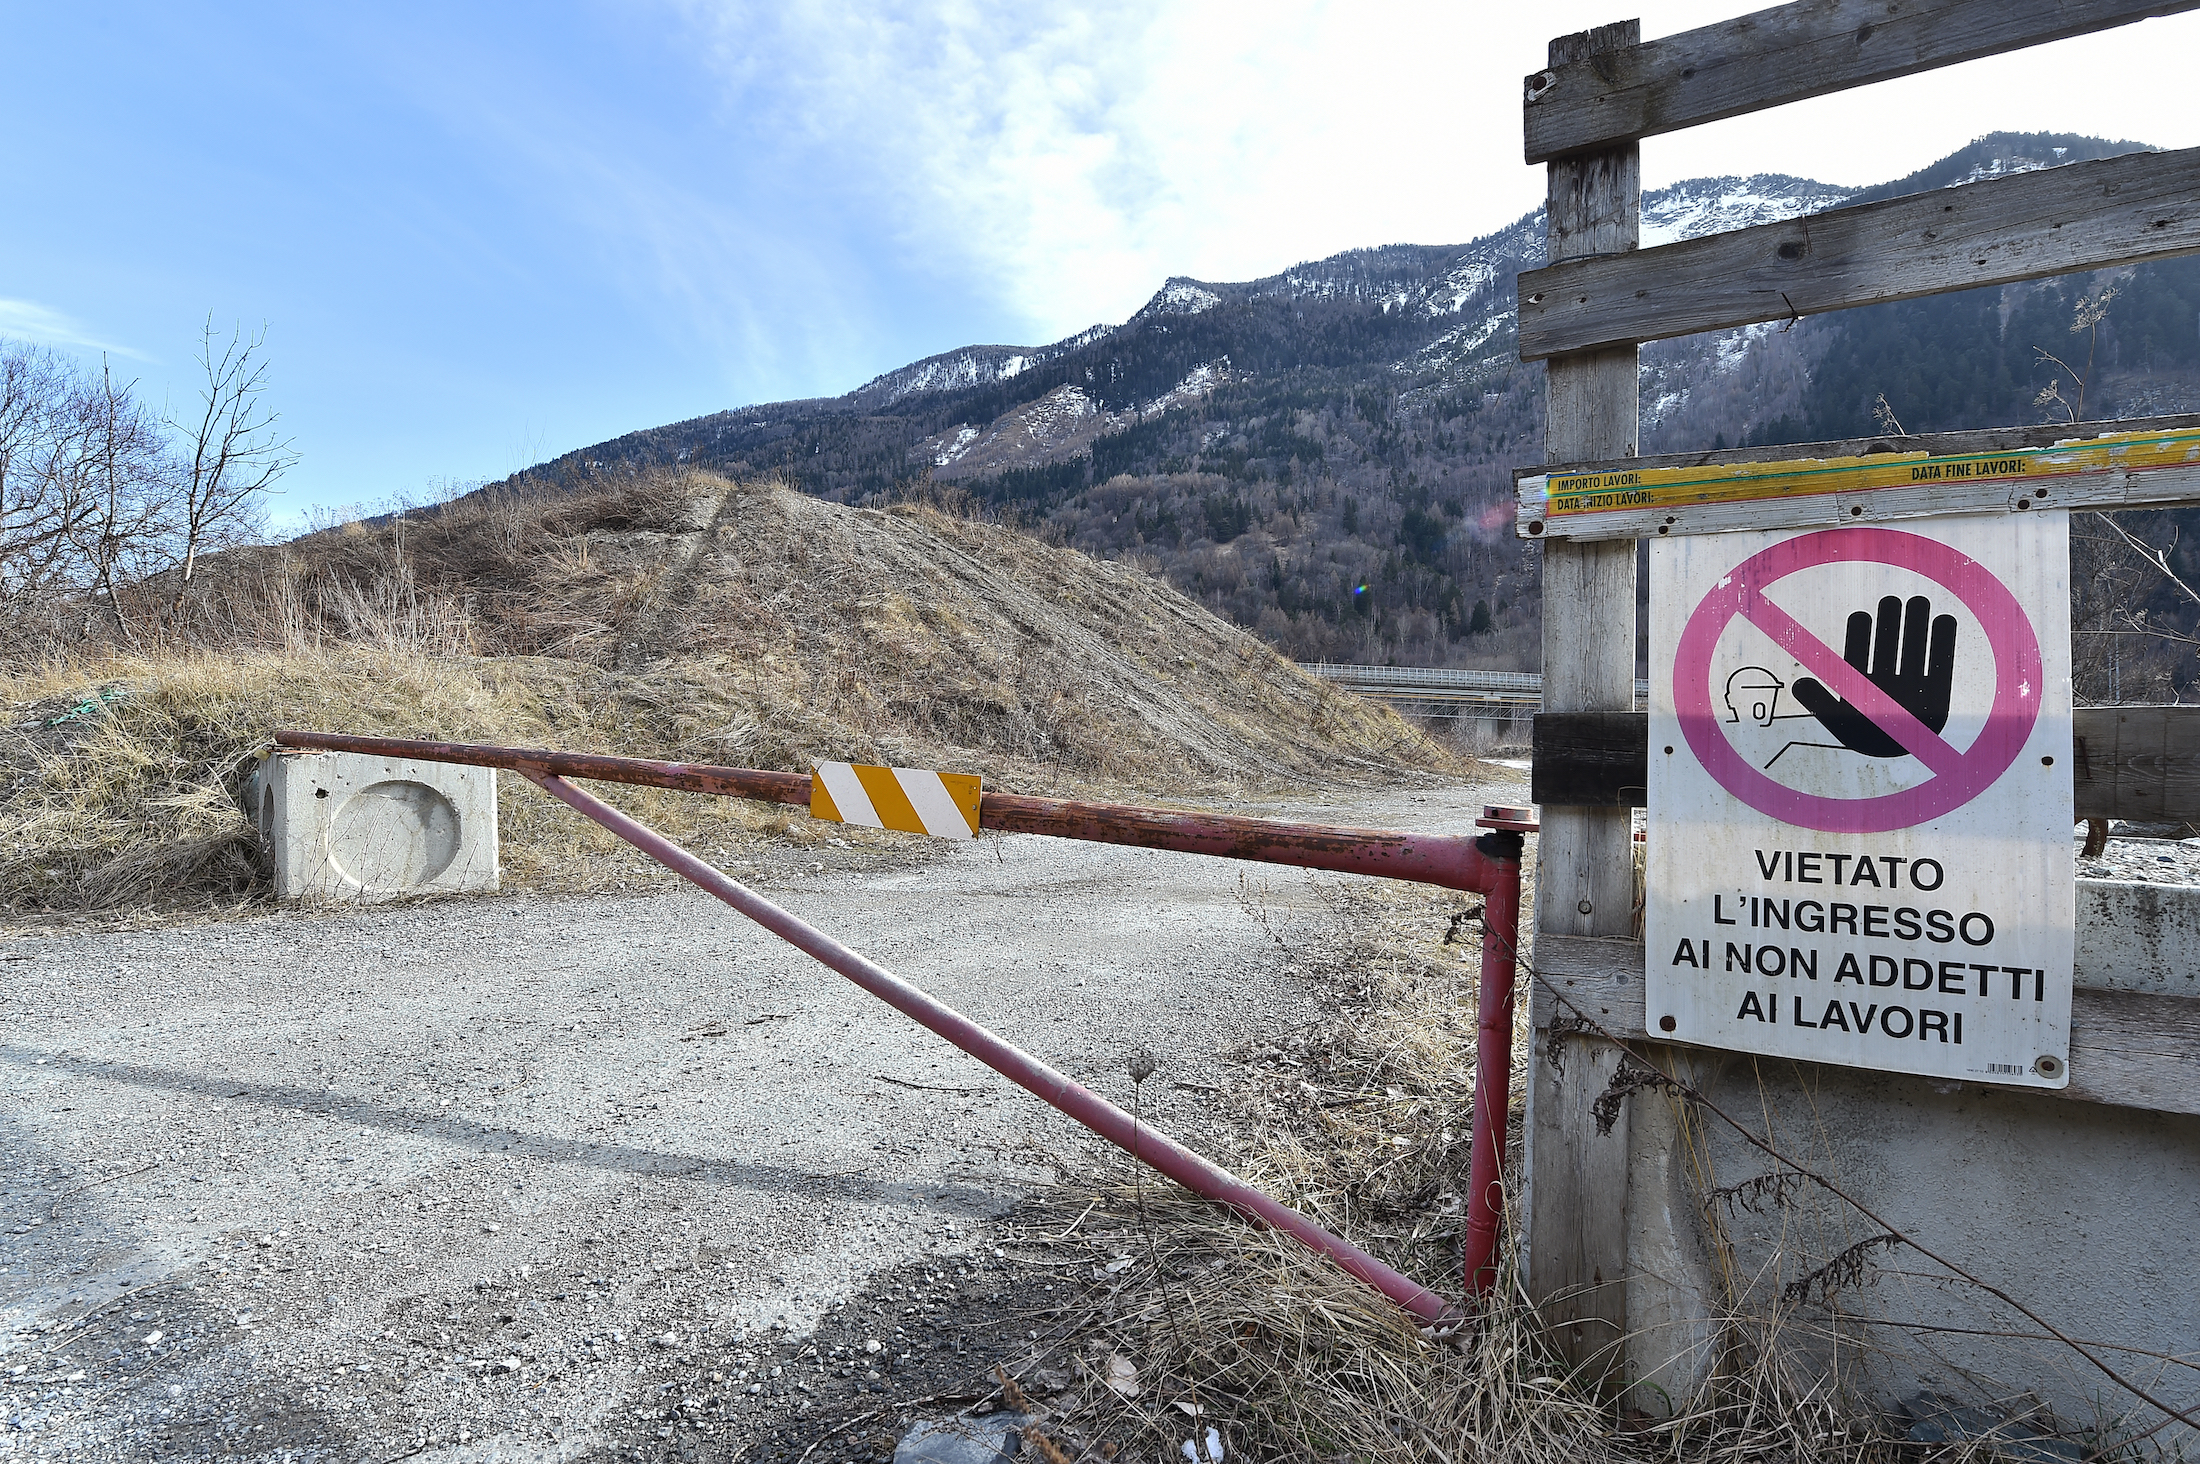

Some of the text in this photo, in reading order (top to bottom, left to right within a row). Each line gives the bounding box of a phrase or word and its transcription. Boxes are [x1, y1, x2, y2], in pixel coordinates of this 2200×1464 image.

[1558, 473, 1641, 491] IMPORTO LAVORI:
[1912, 460, 2025, 480] DATA FINE LAVORI:
[1557, 497, 1580, 510] DATA
[1616, 491, 1654, 506] LAVORI:
[1754, 849, 1944, 891] VIETATO
[1714, 894, 1995, 946] L'INGRESSO
[1672, 938, 2045, 1001] AI NON ADDETTI
[1736, 991, 1963, 1044] AI LAVORI
